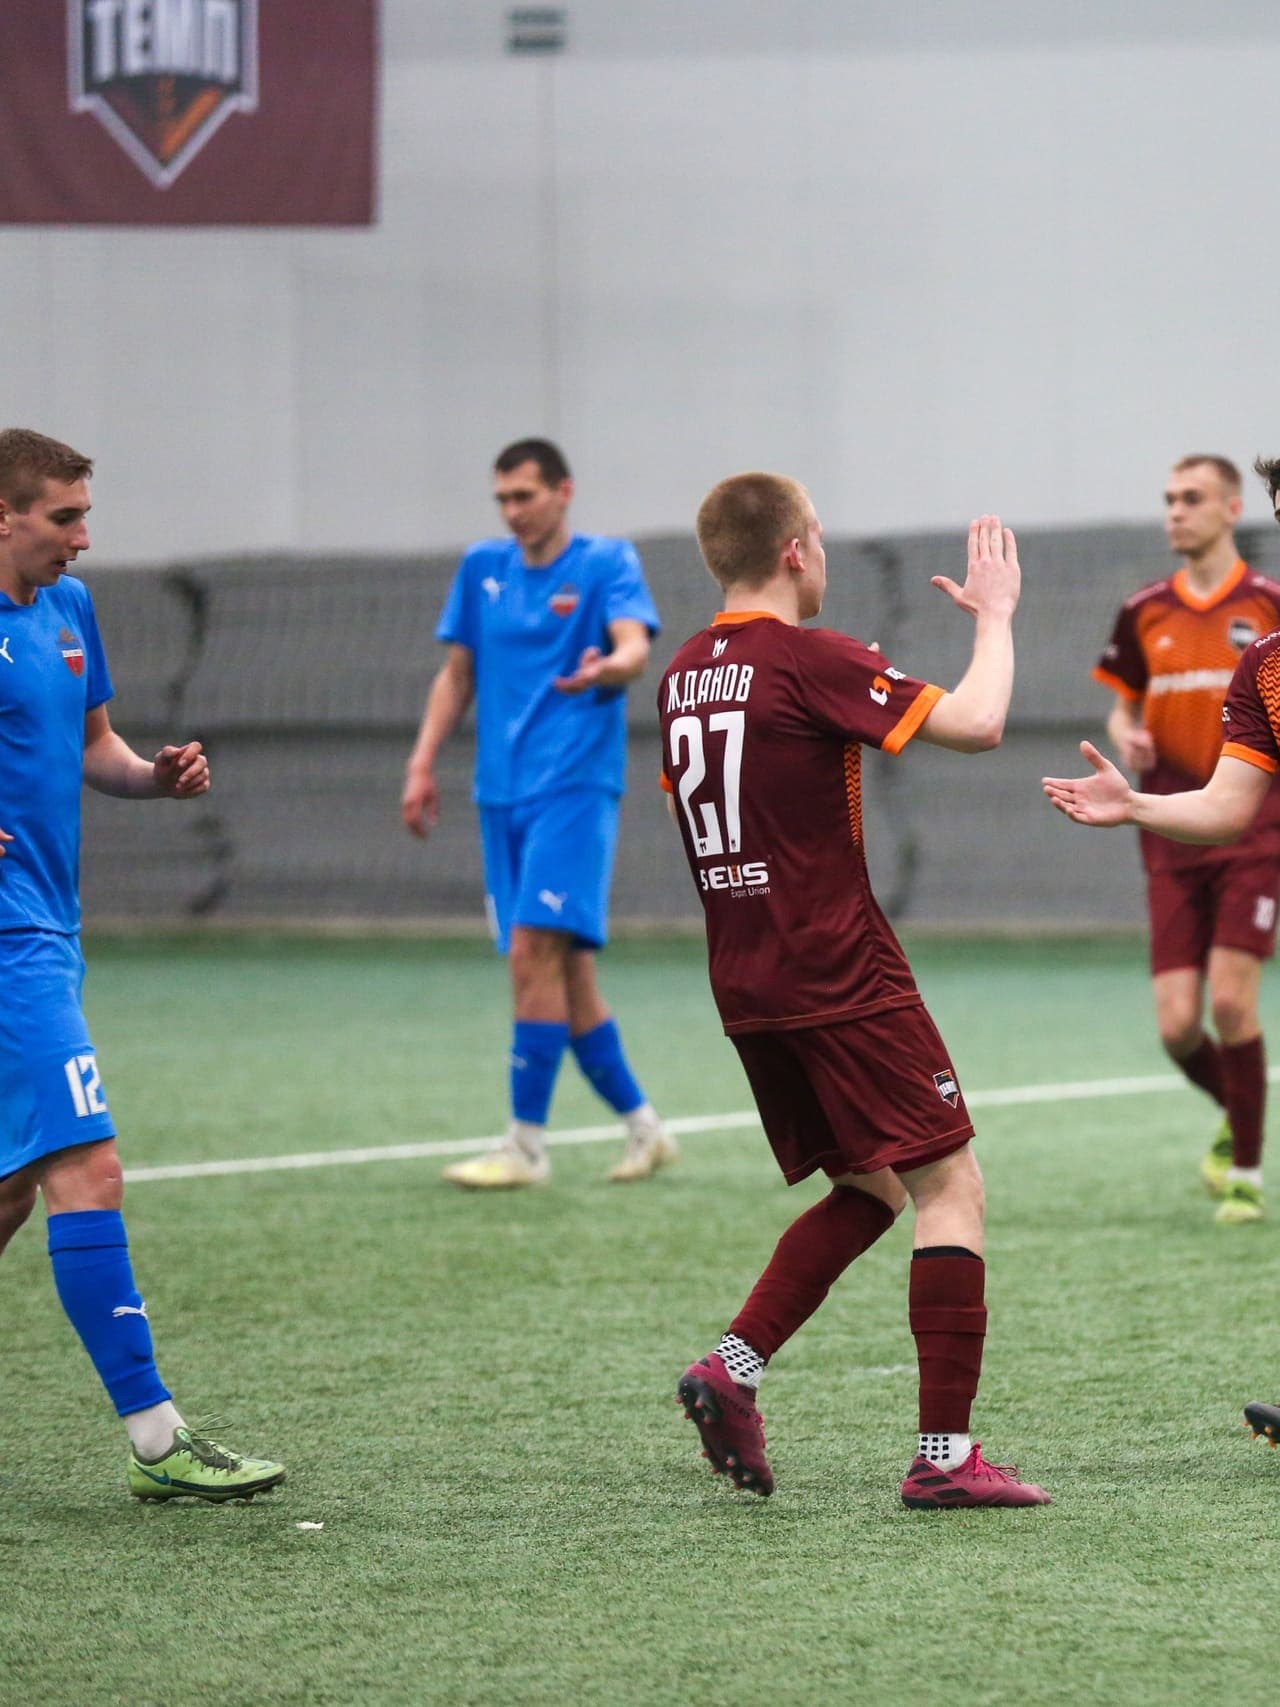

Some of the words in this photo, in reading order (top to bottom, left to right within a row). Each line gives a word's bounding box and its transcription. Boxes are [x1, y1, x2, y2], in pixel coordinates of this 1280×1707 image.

[91, 0, 240, 83] ТЕМП
[666, 663, 755, 713] ЖДАНОВ
[669, 710, 745, 858] 27
[700, 861, 769, 891] SEUS
[64, 1054, 107, 1117] 12
